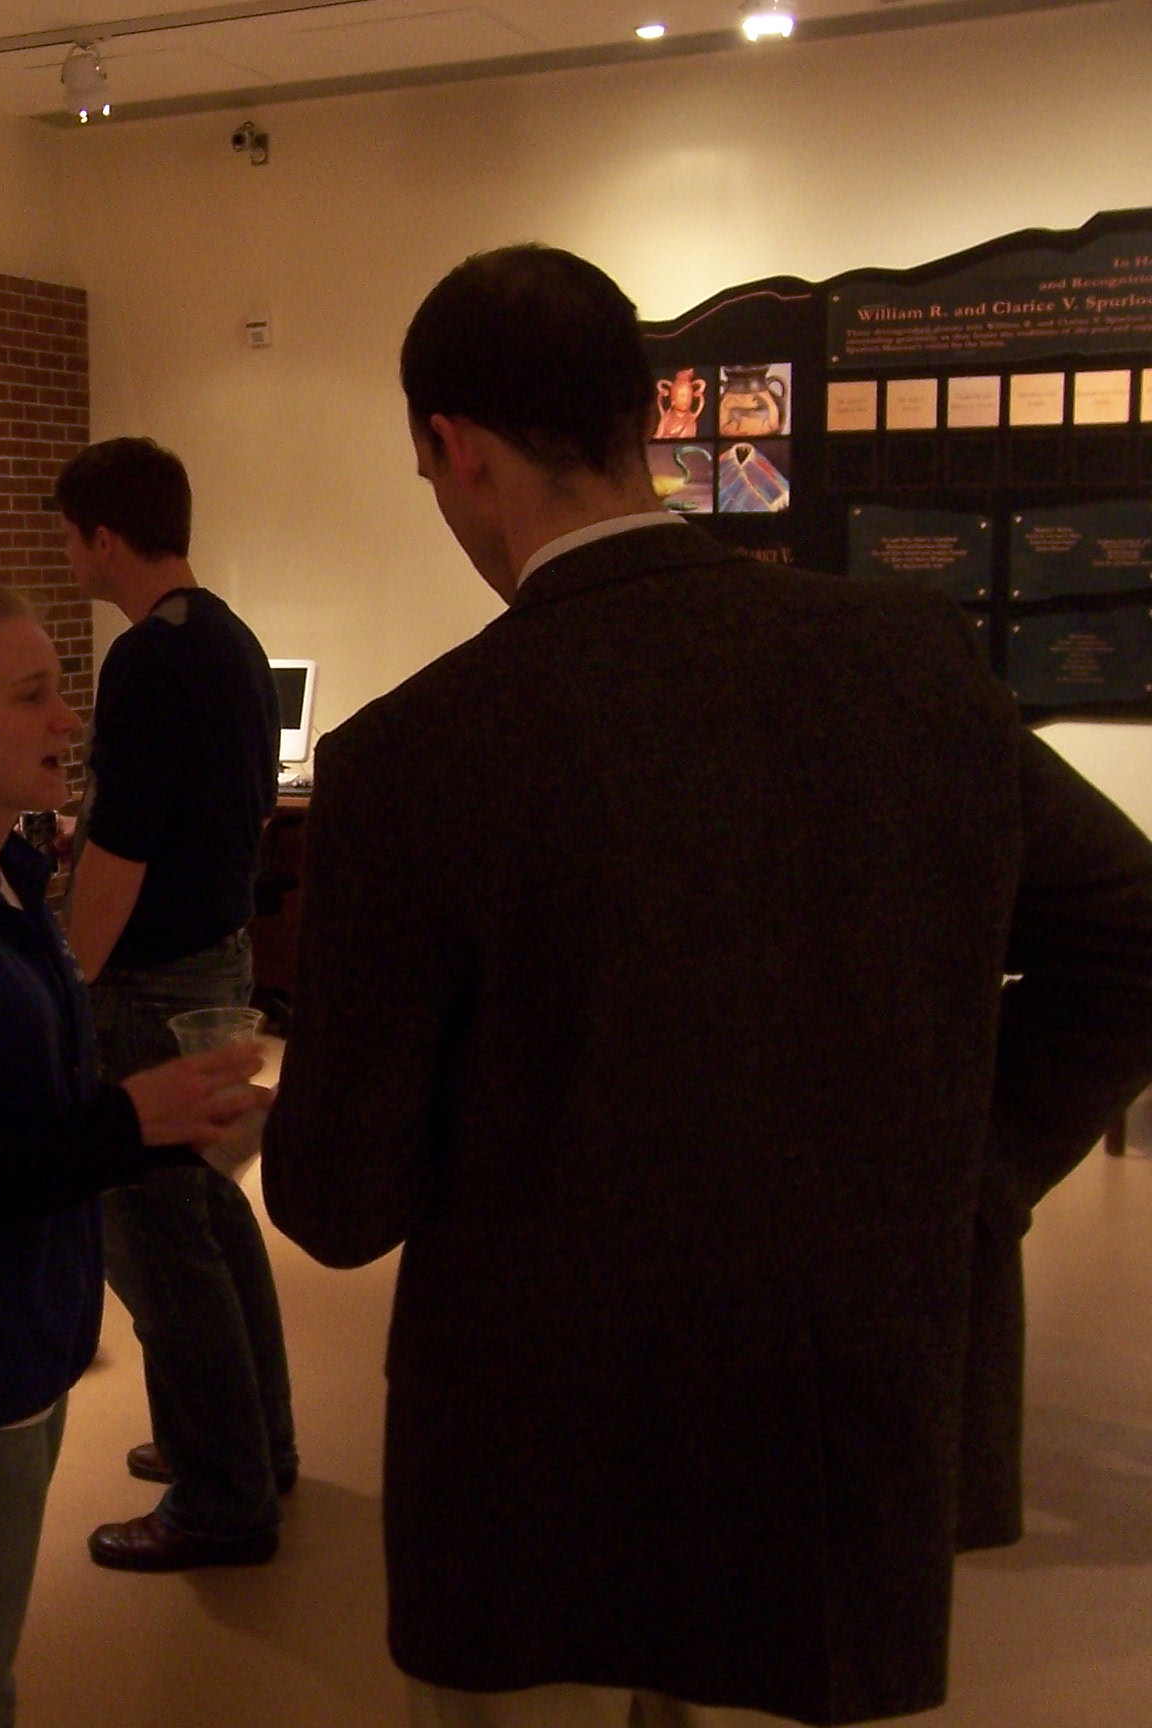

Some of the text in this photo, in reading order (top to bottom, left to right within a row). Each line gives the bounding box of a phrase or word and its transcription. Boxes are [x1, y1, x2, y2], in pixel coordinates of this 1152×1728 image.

[1039, 278, 1066, 291] and
[857, 306, 923, 322] William
[930, 305, 947, 318] R.
[955, 302, 986, 317] and
[992, 299, 1056, 315] Clarice
[1061, 297, 1078, 311] V.
